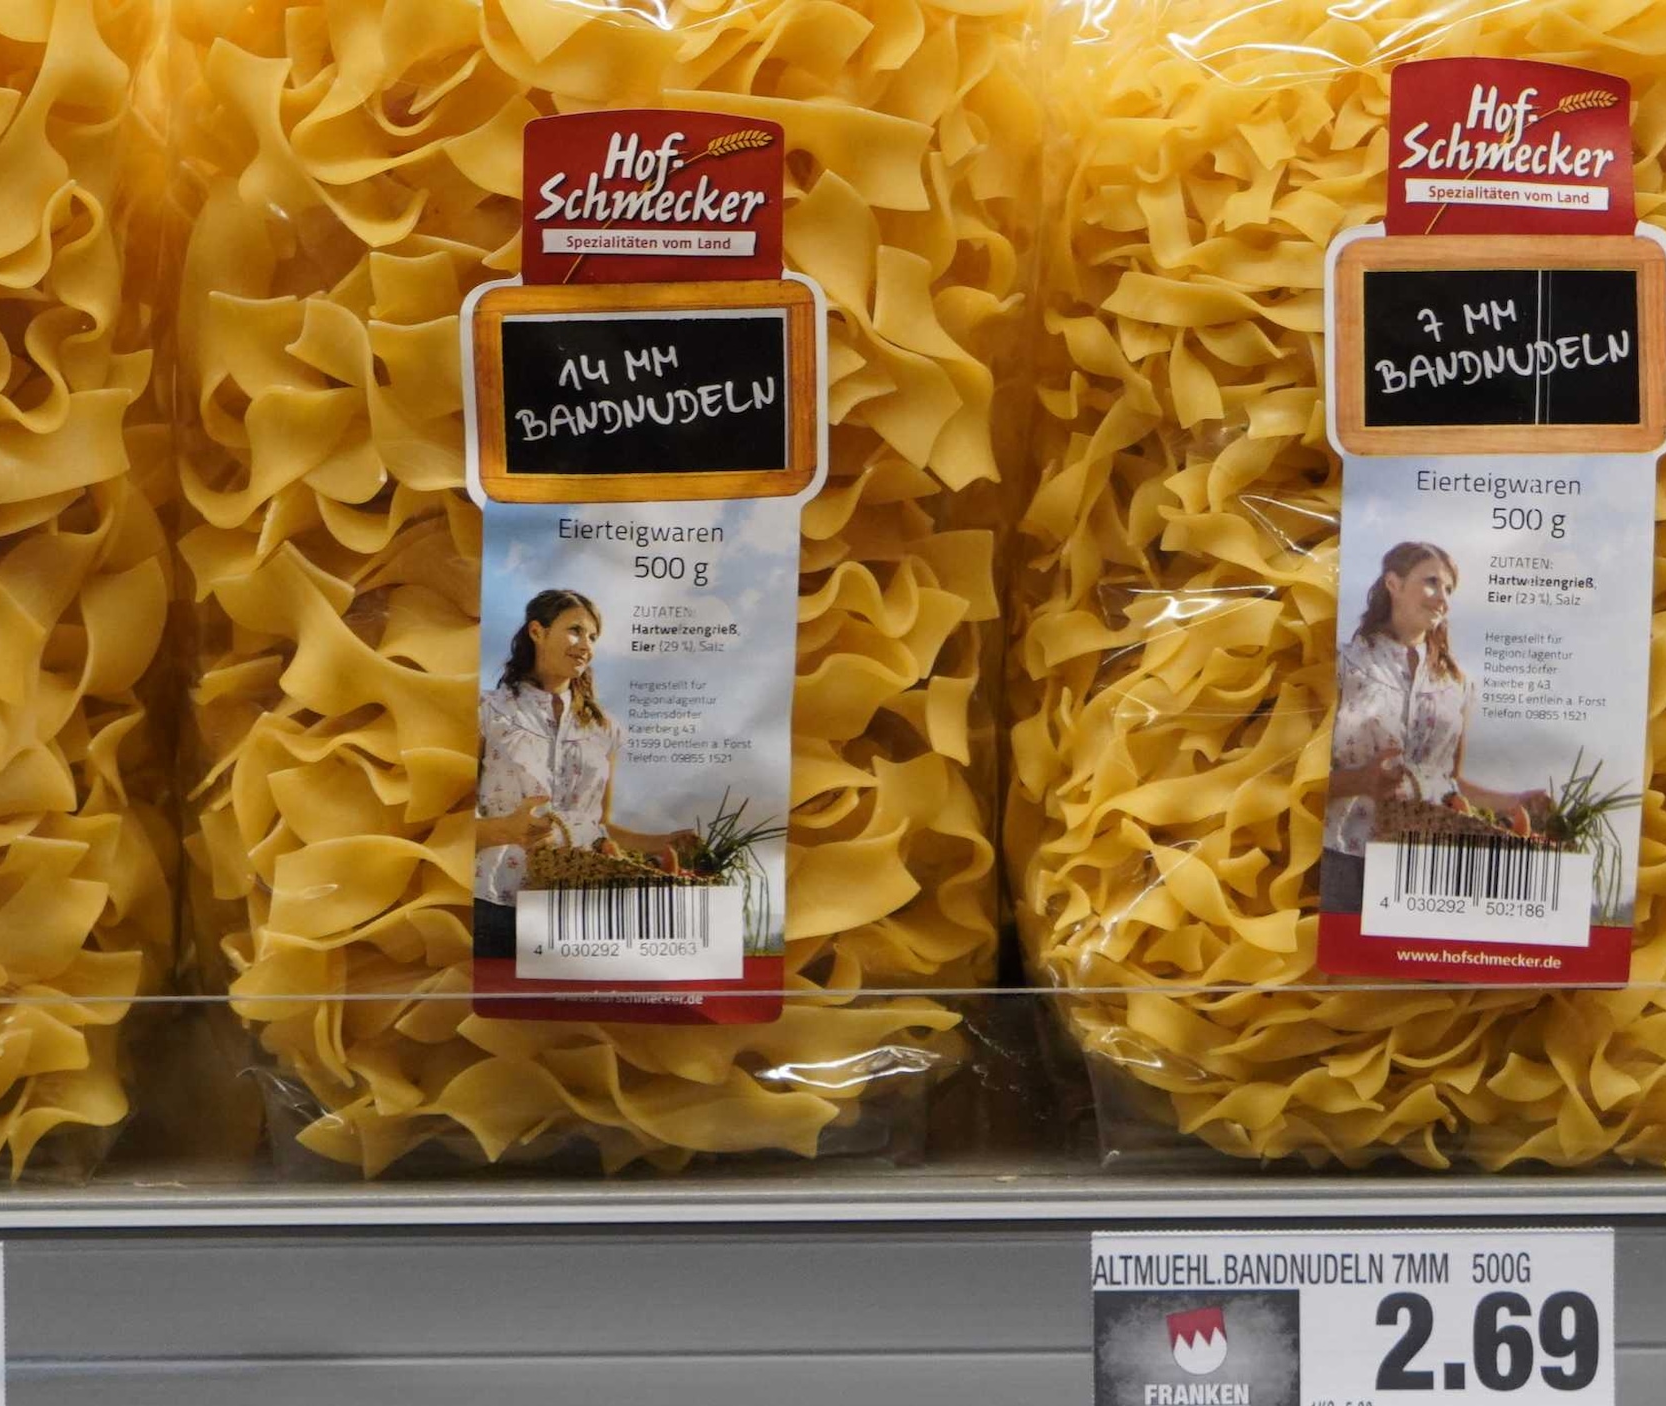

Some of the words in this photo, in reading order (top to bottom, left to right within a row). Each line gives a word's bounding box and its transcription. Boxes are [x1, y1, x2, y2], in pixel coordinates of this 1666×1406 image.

[1466, 83, 1539, 145] Hof-
[604, 131, 685, 194] Hof-
[1398, 122, 1615, 178] Schmecker
[535, 172, 765, 223] Schmecker
[1428, 185, 1519, 202] Spezialitäten
[1524, 191, 1553, 201] vom
[1557, 190, 1590, 204] Land
[566, 236, 657, 249] Spezialitäten
[662, 238, 692, 249] vom
[697, 237, 731, 249] Land
[1417, 308, 1443, 343] 7
[1463, 299, 1517, 335] MM
[558, 354, 610, 391] 14
[627, 345, 678, 382] MM
[1375, 329, 1630, 394] BANDNUDELN
[515, 376, 775, 442] BANDNUDELN
[1417, 470, 1581, 499] Eierteigwaren
[559, 518, 724, 547] Eierteigwaren
[1492, 508, 1542, 531] 500
[1551, 512, 1565, 538] g
[1397, 949, 1562, 969] www.hofschmecker.de
[1093, 1254, 1384, 1286] ALTMUEHL.BANDNUDELN
[1392, 1254, 1449, 1283] 7MM
[1472, 1253, 1531, 1283] 500G
[1375, 1290, 1600, 1392] 2.69
[1145, 1384, 1250, 1406] FRANKEN
